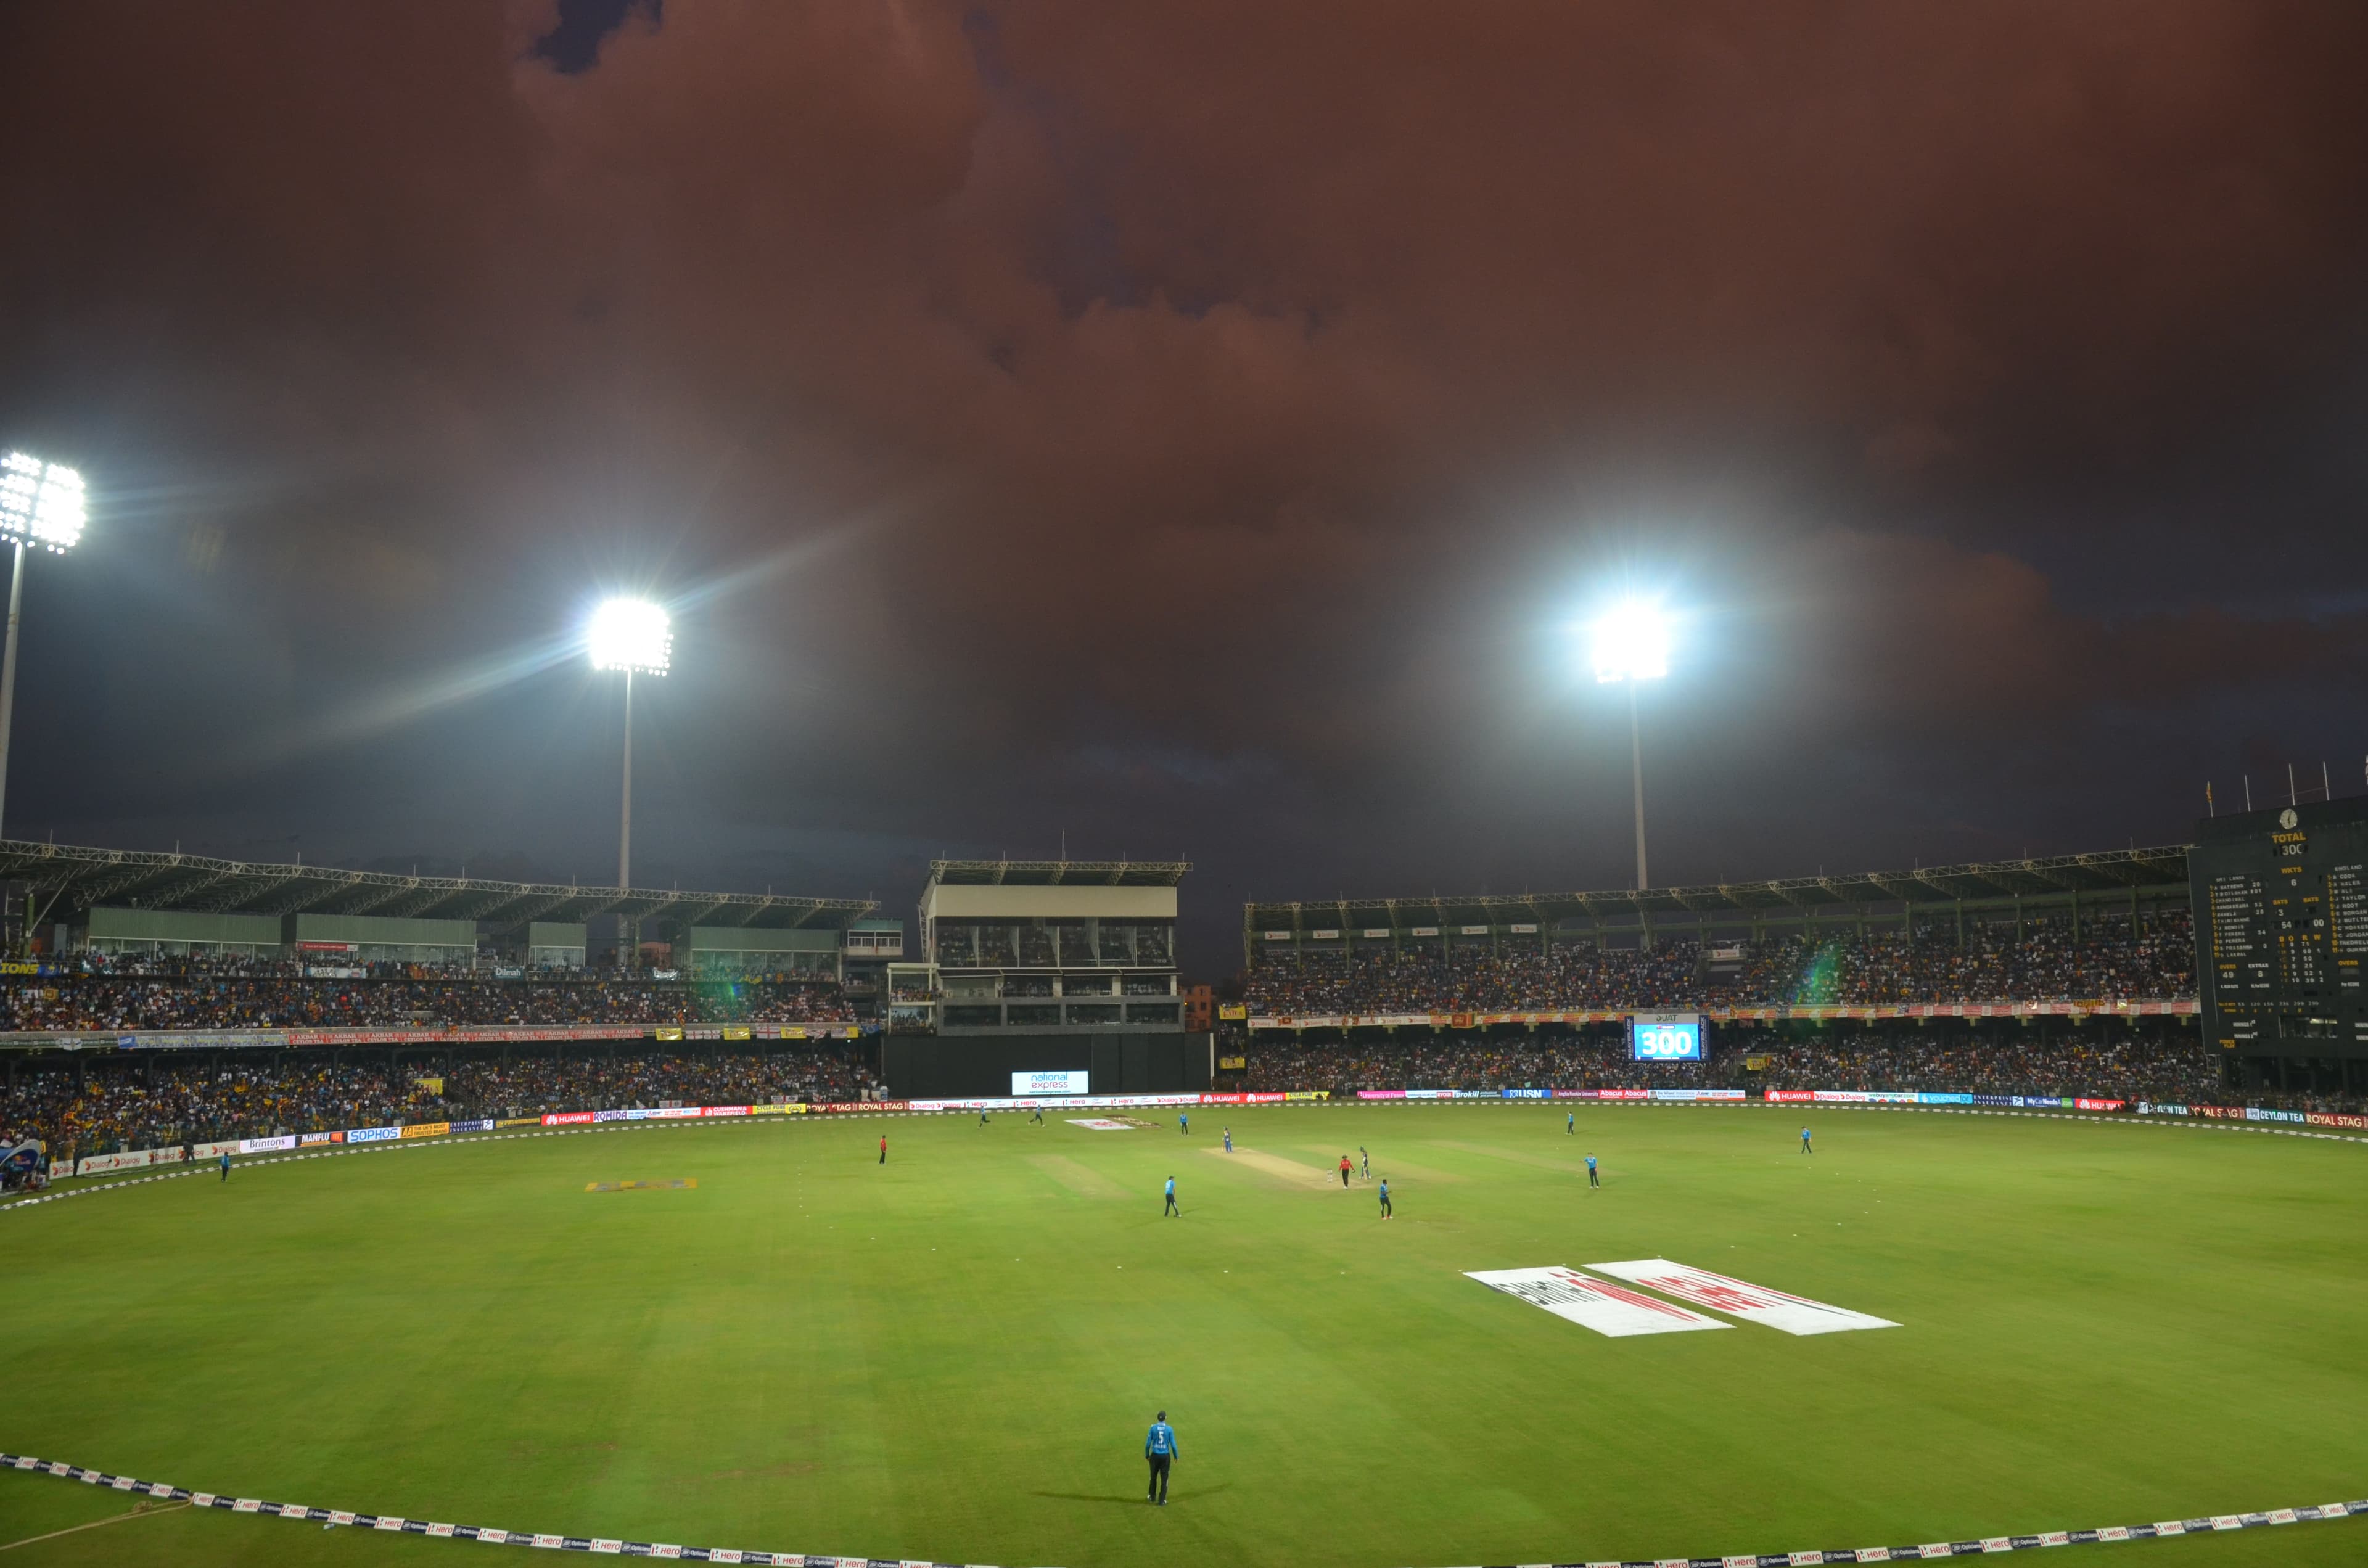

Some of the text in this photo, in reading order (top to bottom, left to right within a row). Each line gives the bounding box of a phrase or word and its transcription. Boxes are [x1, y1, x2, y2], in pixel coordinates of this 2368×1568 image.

[2272, 832, 2306, 844] TOTAL
[2281, 919, 2324, 929] 54 00
[0, 963, 39, 974] IONS
[496, 967, 521, 977] Dilmah
[1642, 1032, 1692, 1055] 300
[1031, 1071, 1068, 1082] national
[1031, 1082, 1068, 1090] express
[1519, 1090, 1543, 1098] USN
[2174, 1106, 2188, 1115] TEA
[559, 1115, 590, 1123] HUAWEI
[594, 1110, 627, 1122] ROMIDA
[2259, 1110, 2304, 1122] CEYLON TEA
[2306, 1114, 2362, 1127] ROYAL STAG
[350, 1128, 398, 1143] SOPHOS
[401, 1127, 413, 1137] AA
[301, 1132, 330, 1143] MANFLU
[249, 1138, 286, 1149] Brintons
[121, 1157, 141, 1166] Dialog
[155, 1152, 175, 1161] Dialog
[92, 1161, 110, 1170] Dialog
[1158, 1431, 1164, 1444] 5
[1800, 1554, 1821, 1562] Hero
[845, 1560, 865, 1568] Hero
